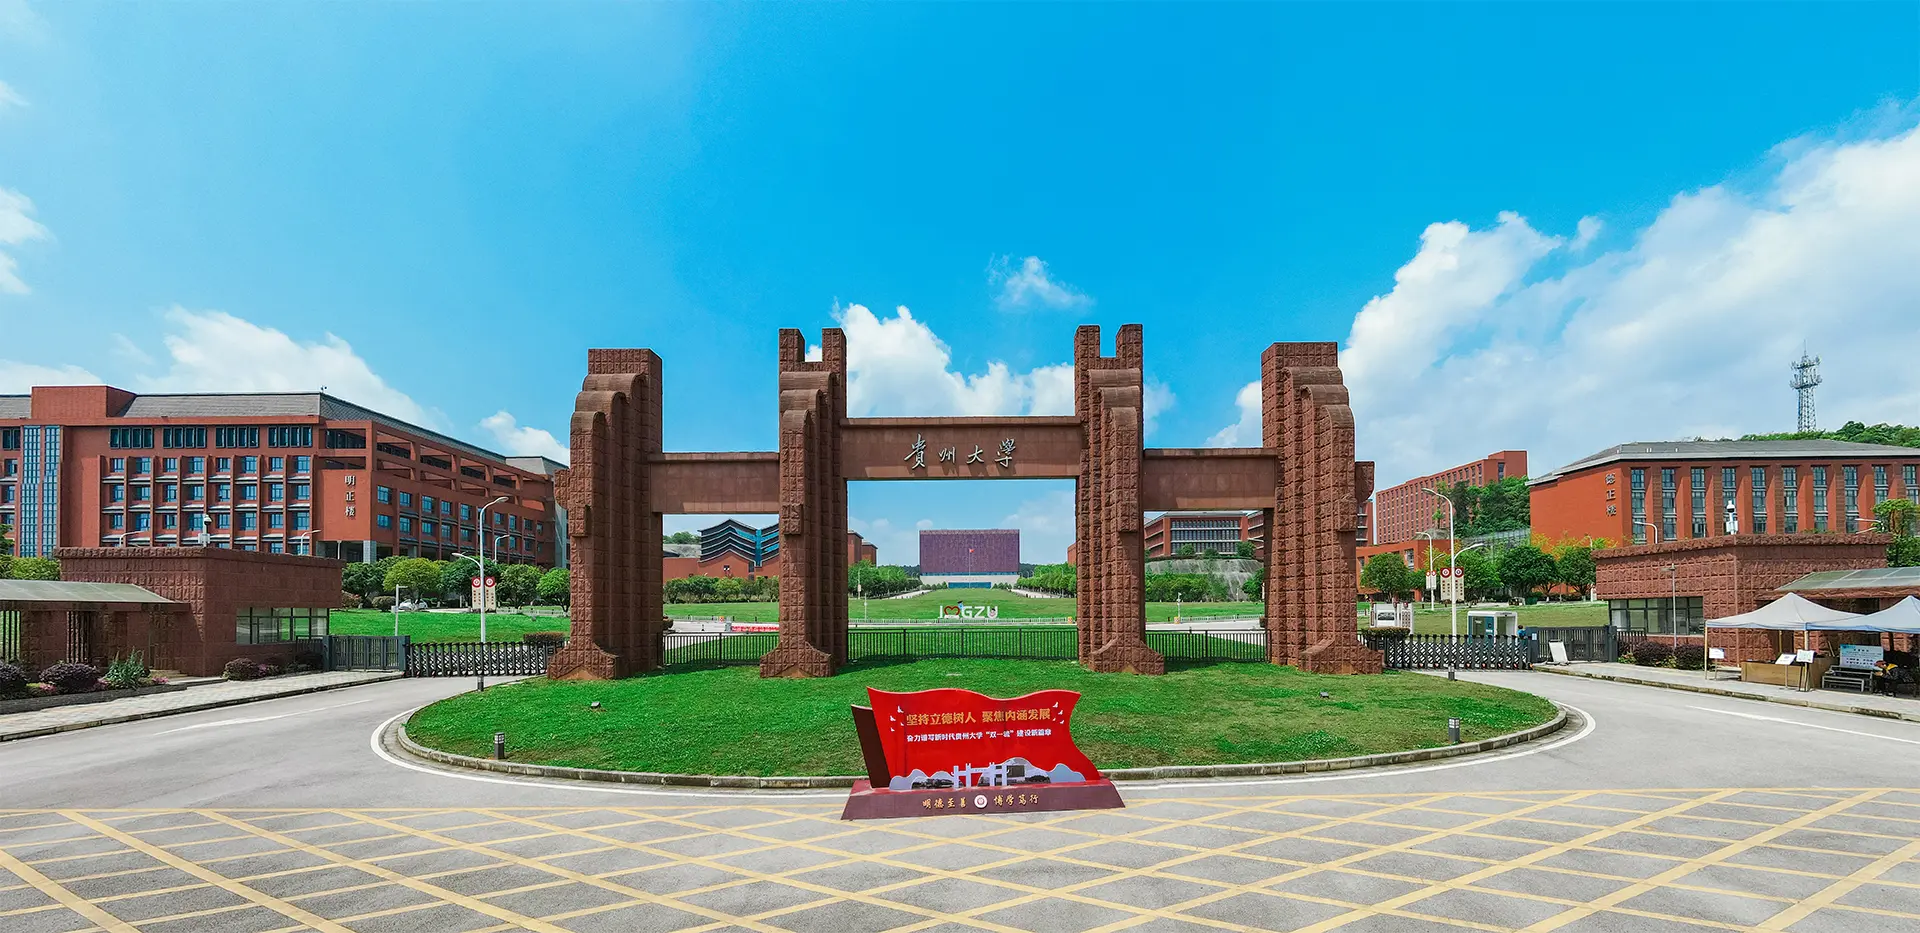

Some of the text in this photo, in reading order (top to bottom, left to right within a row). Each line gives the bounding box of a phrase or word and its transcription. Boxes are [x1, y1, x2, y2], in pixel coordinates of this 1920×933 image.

[904, 434, 1016, 469] 貴州大學
[961, 605, 998, 618] GZU
[906, 708, 1051, 726] 坚持立德树人 聚焦内涵发展
